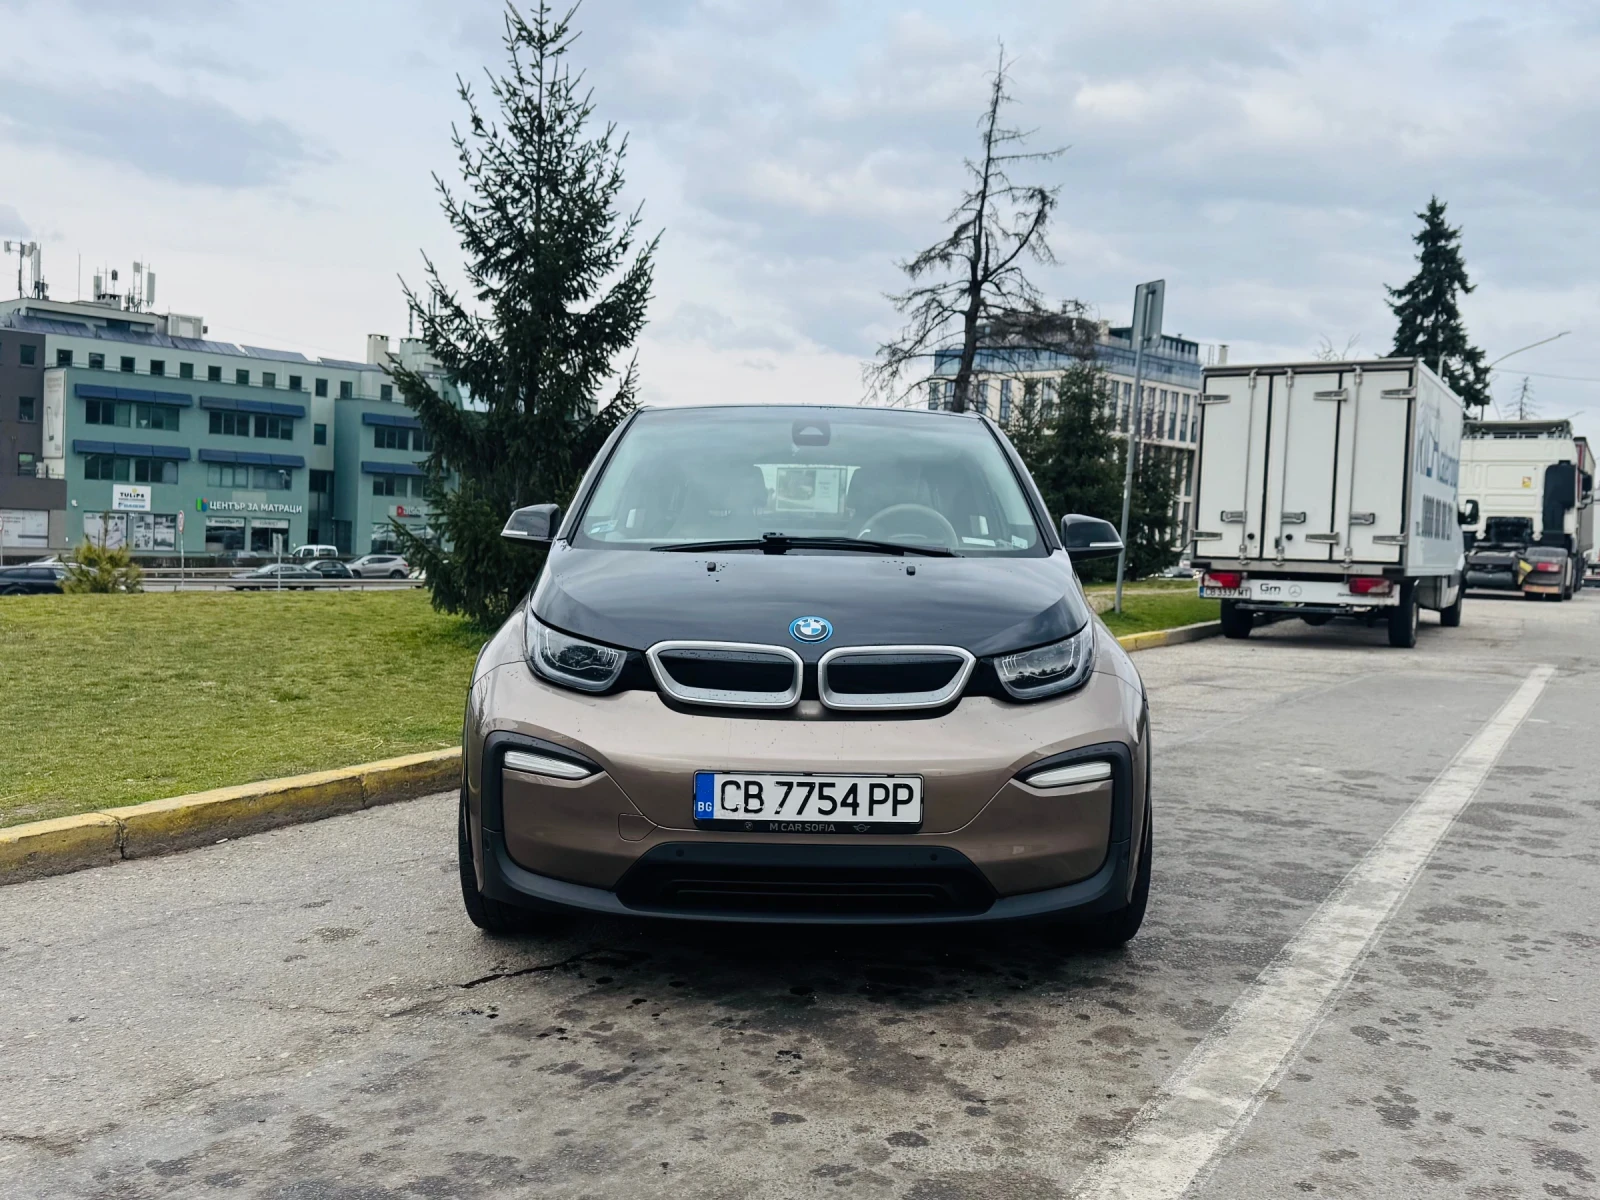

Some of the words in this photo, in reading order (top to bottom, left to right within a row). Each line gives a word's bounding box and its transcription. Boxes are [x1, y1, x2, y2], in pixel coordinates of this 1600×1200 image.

[209, 501, 246, 511] ЦЕНТЪР
[247, 502, 259, 511] ЗА
[260, 503, 303, 514] МАТРАЦИ
[720, 779, 764, 814] CB
[774, 781, 860, 816] 7754
[868, 782, 914, 817] PP
[697, 801, 713, 812] BG
[769, 822, 779, 831] M
[780, 823, 802, 832] CAR
[804, 823, 836, 832] SOFIA
